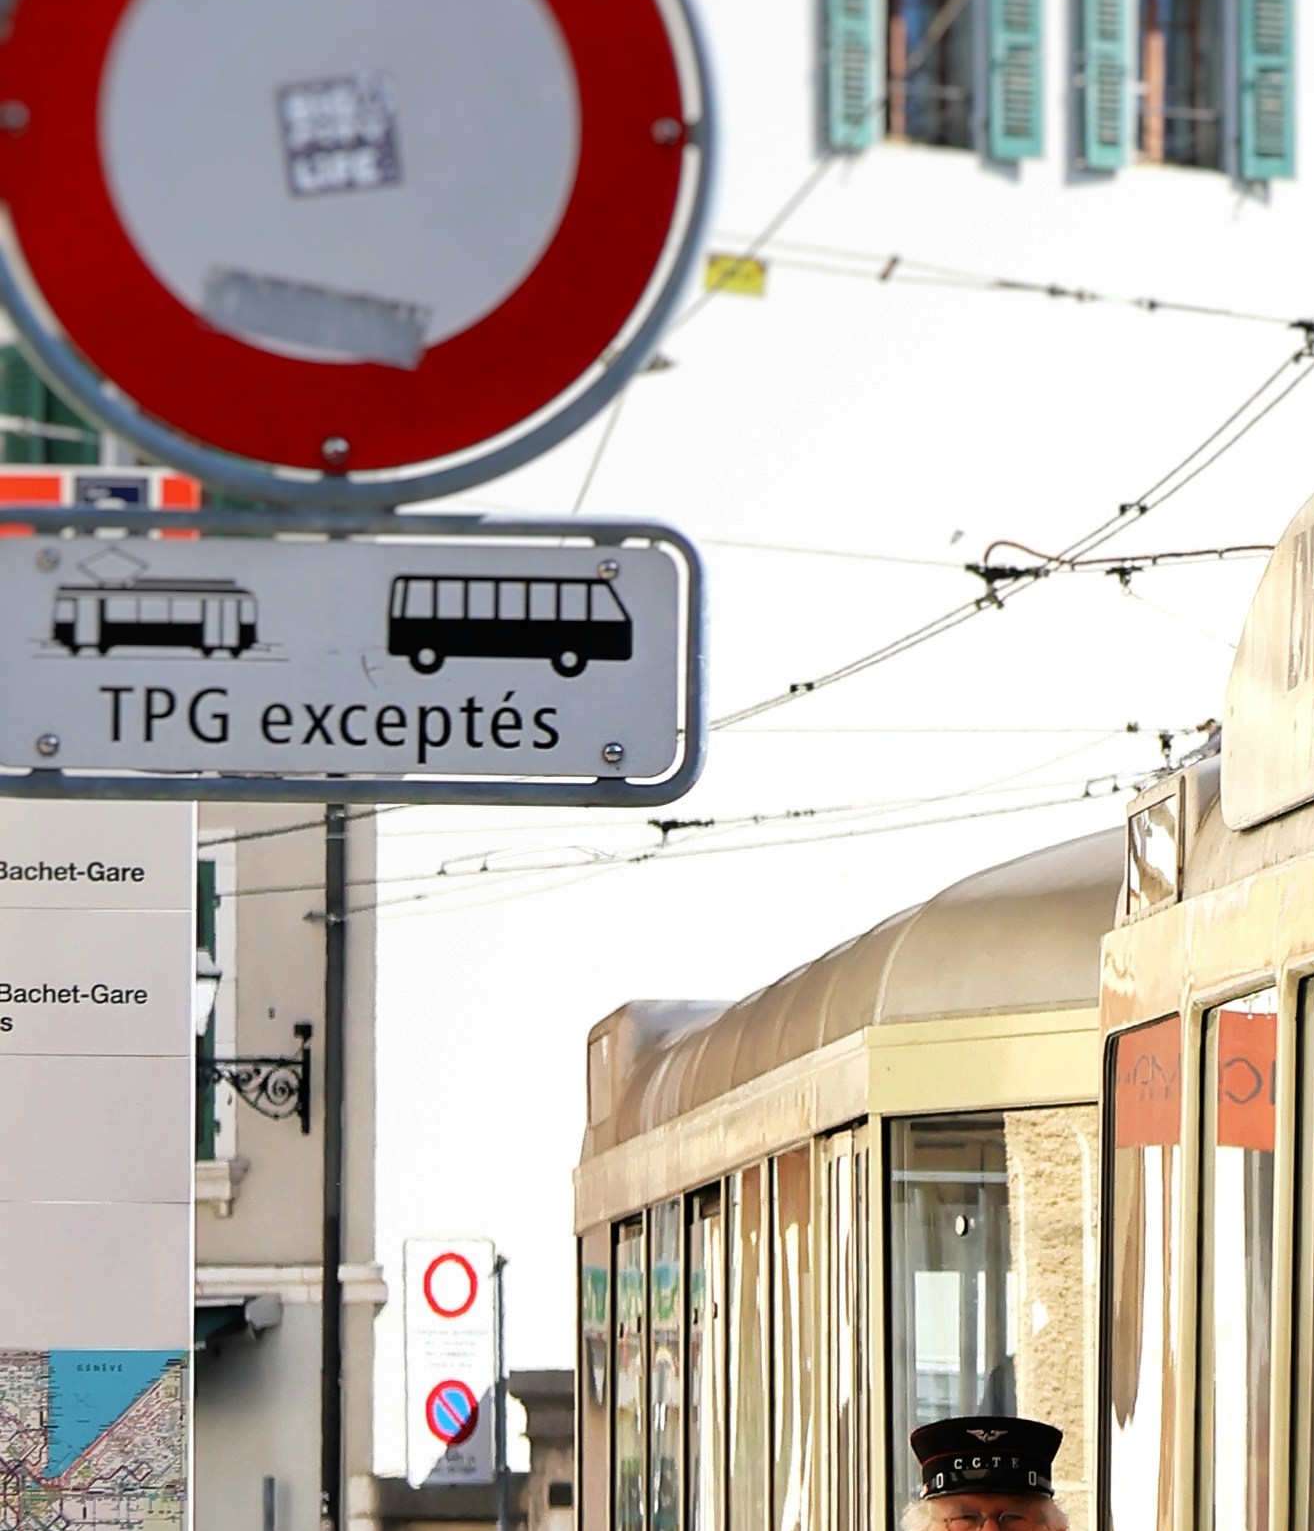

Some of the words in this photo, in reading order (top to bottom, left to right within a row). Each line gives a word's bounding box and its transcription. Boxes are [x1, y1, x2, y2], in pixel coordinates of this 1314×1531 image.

[100, 686, 230, 743] TPG
[260, 691, 560, 763] exceptés
[0, 984, 148, 1005] Bachet-Gare
